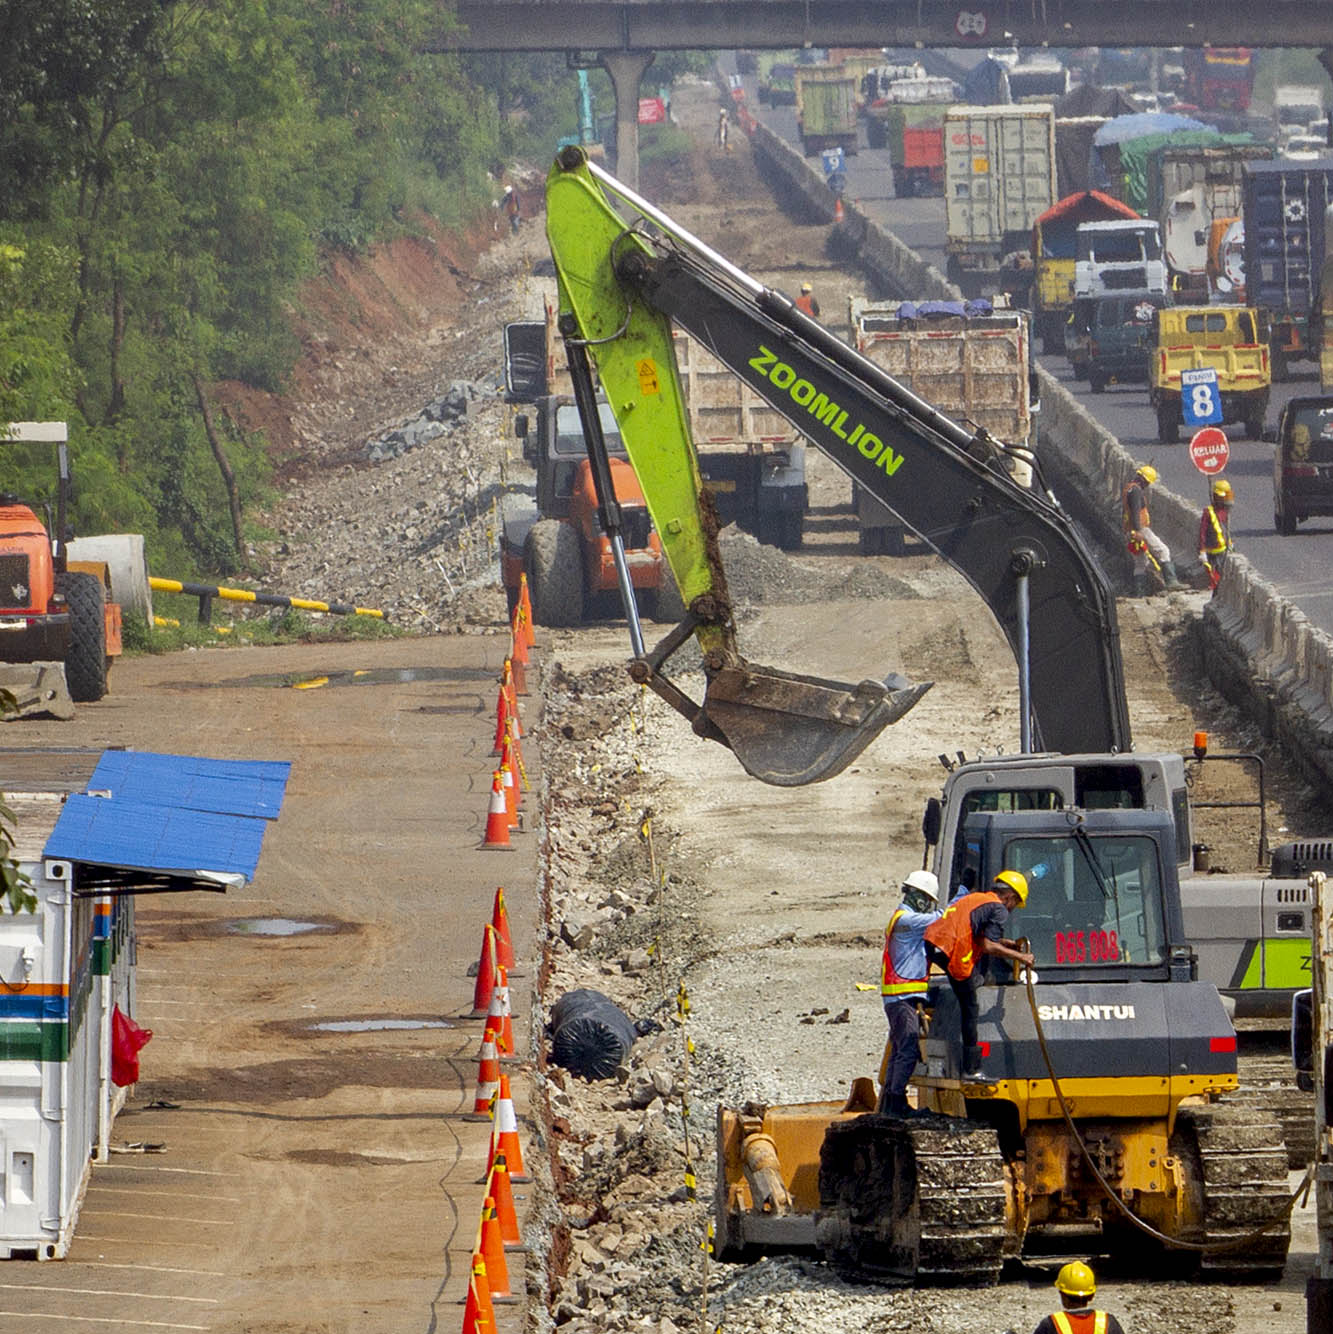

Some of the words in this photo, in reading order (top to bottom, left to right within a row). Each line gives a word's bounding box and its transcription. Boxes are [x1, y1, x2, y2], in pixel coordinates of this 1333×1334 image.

[748, 344, 905, 477] ZOOMLION
[1191, 384, 1214, 418] 8
[1193, 443, 1227, 457] KELUAR
[1055, 930, 1086, 964] D65
[1089, 929, 1119, 963] 008
[1038, 1004, 1136, 1021] SHANTUI
